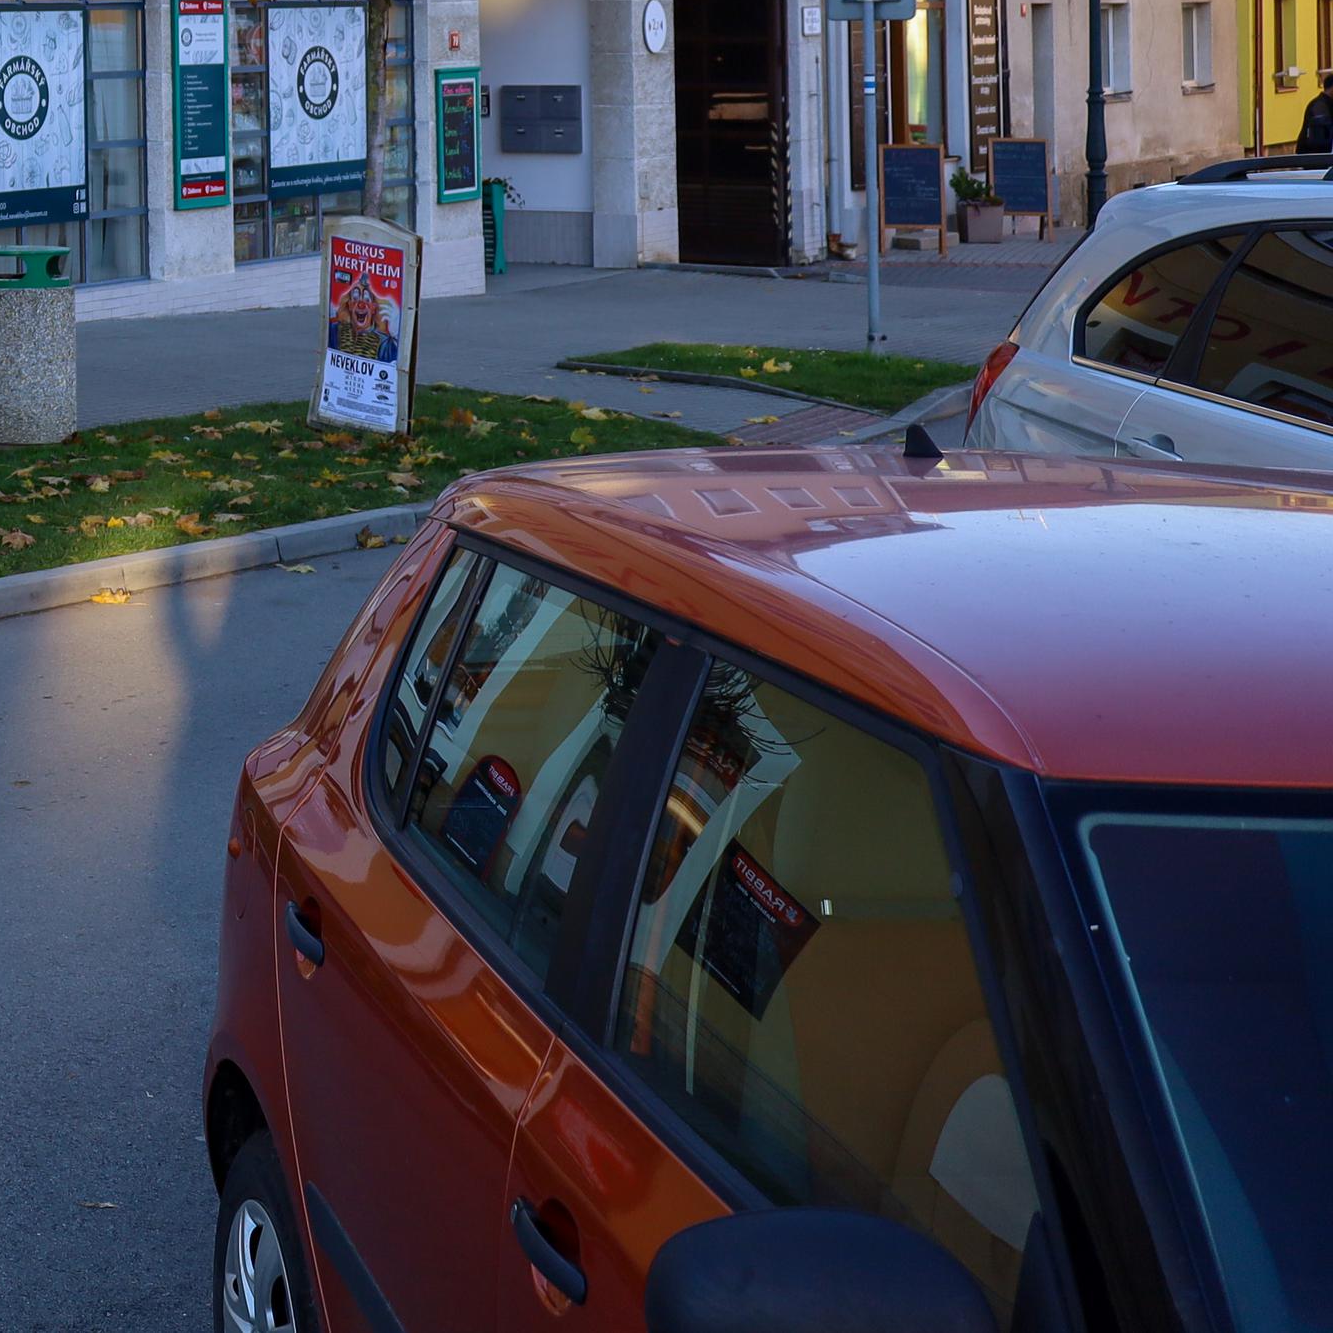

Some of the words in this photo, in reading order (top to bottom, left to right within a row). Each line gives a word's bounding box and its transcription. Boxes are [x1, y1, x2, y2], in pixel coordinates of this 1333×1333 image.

[304, 100, 332, 116] OBCHOD
[4, 117, 40, 136] OBCHOD
[344, 242, 386, 260] CIRKUS
[333, 254, 401, 278] WERTHEIM
[330, 353, 375, 376] NEVEKLOV
